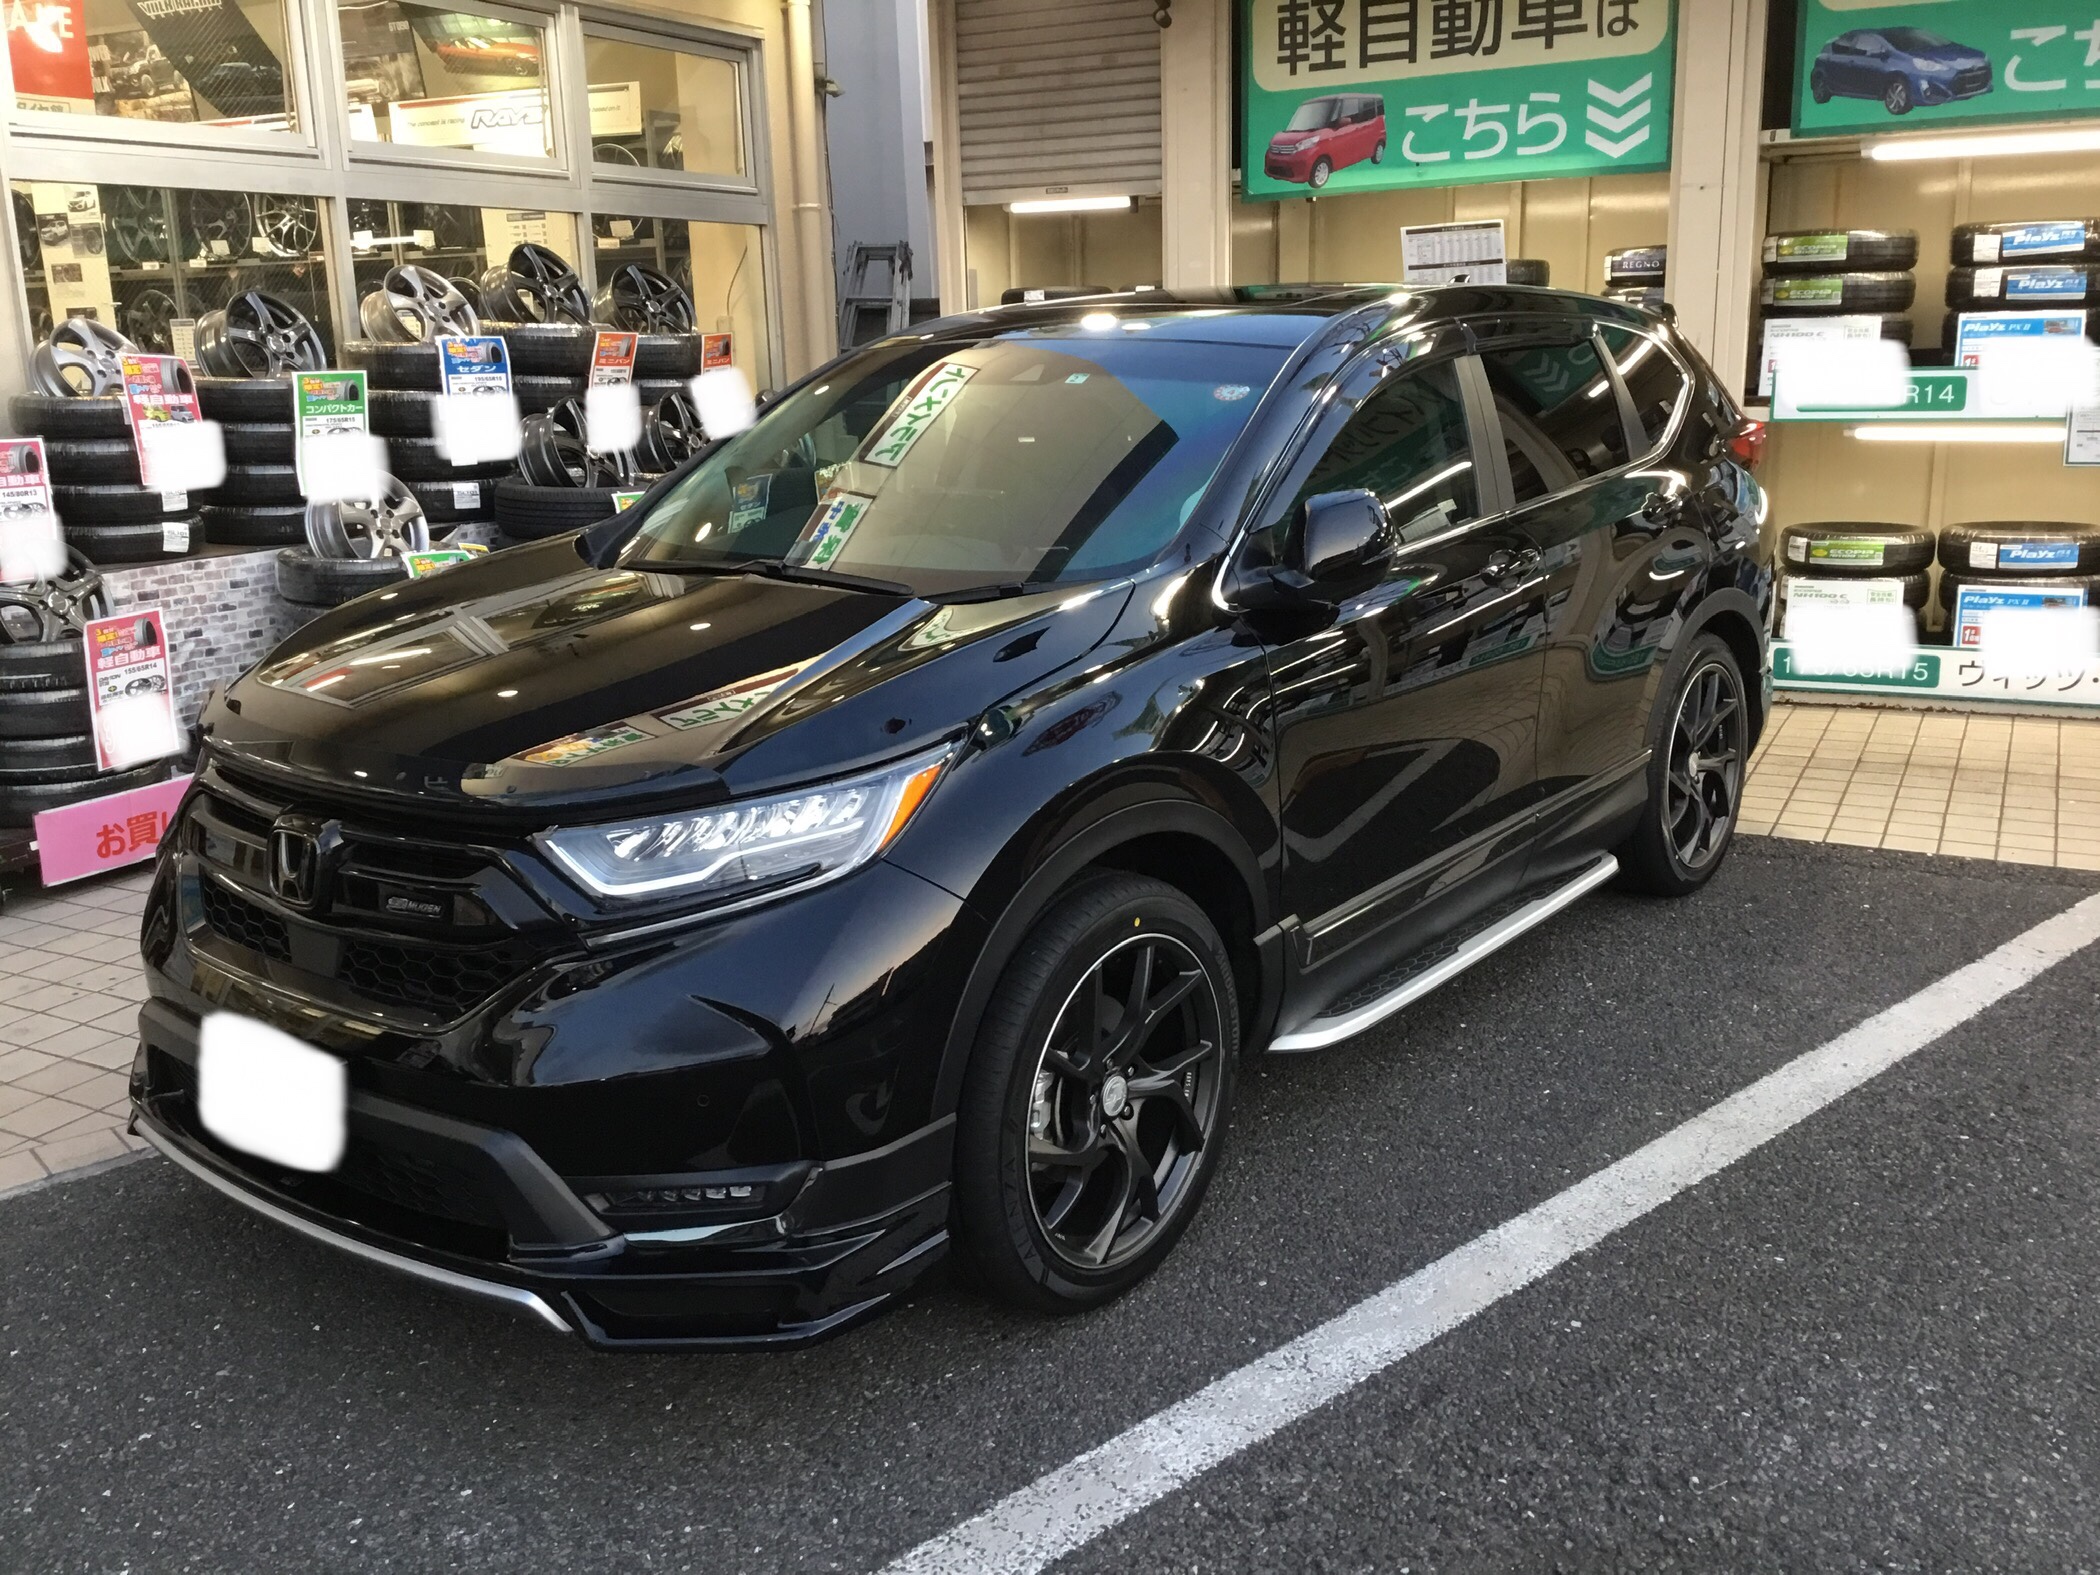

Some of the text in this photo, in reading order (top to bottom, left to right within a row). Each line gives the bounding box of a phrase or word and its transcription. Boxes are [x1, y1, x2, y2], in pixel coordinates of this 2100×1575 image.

[1276, 0, 1639, 76] 軽自動車は
[471, 104, 549, 129] RAYS
[1402, 92, 1568, 163] こちら
[1622, 260, 1660, 269] REGNO
[456, 364, 497, 374] セダン
[305, 403, 364, 414] コンパクトカー
[97, 645, 162, 670] 軽自動車
[124, 662, 158, 675] 155/65R14
[408, 900, 442, 913] MUGEN
